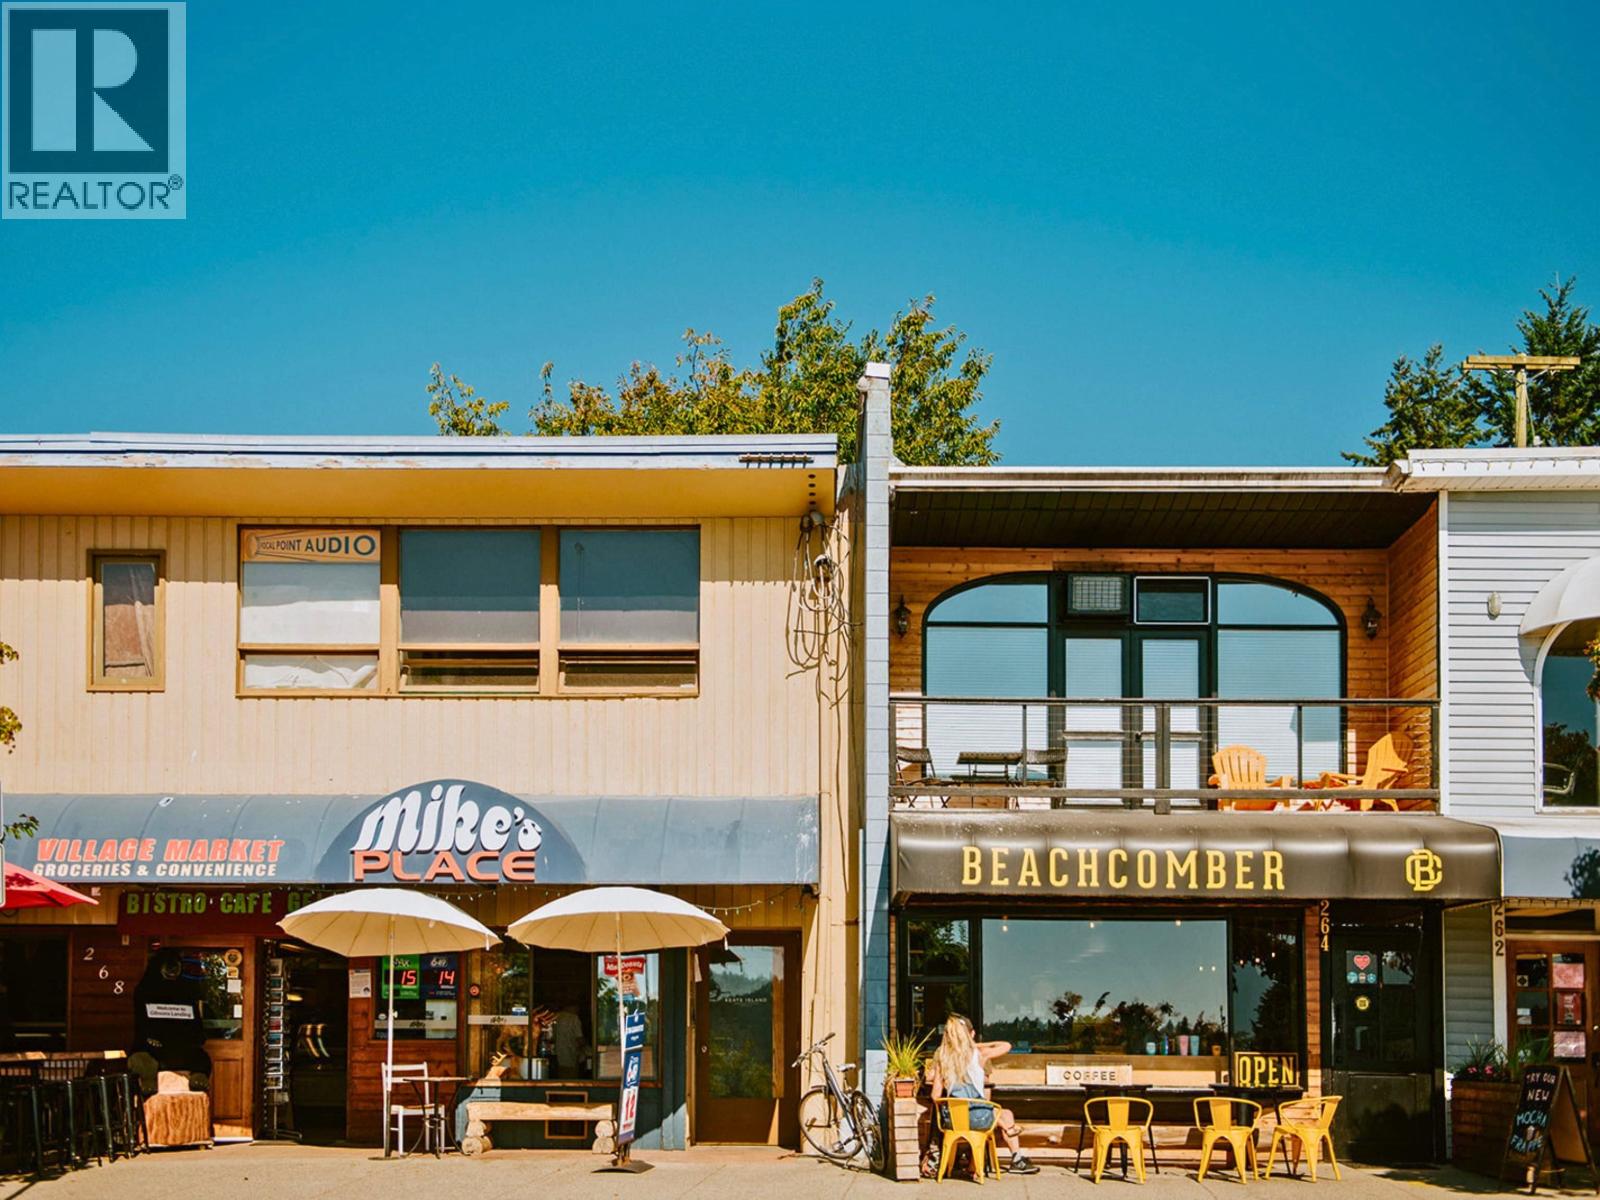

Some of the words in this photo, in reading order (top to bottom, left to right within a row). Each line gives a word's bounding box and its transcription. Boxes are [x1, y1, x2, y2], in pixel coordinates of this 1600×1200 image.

[276, 539, 302, 551] POINT
[305, 535, 376, 555] AUDIO
[350, 784, 543, 855] Mike's
[37, 838, 157, 862] VILLAGE
[163, 838, 286, 862] MARKET
[32, 863, 132, 877] GROCERIES
[136, 864, 149, 876] &
[155, 863, 278, 877] CONVENIENCE
[353, 850, 537, 882] PLACE
[962, 846, 1285, 891] BEACHCOMBER
[126, 892, 207, 914] BISTRO
[219, 892, 273, 914] CAFE
[401, 970, 416, 986] 15
[438, 970, 455, 985] 14
[1063, 1070, 1116, 1081] COFFEE
[1239, 1056, 1294, 1084] OPEN
[1526, 1088, 1550, 1101] NEW
[1516, 1109, 1548, 1127] MOCHA
